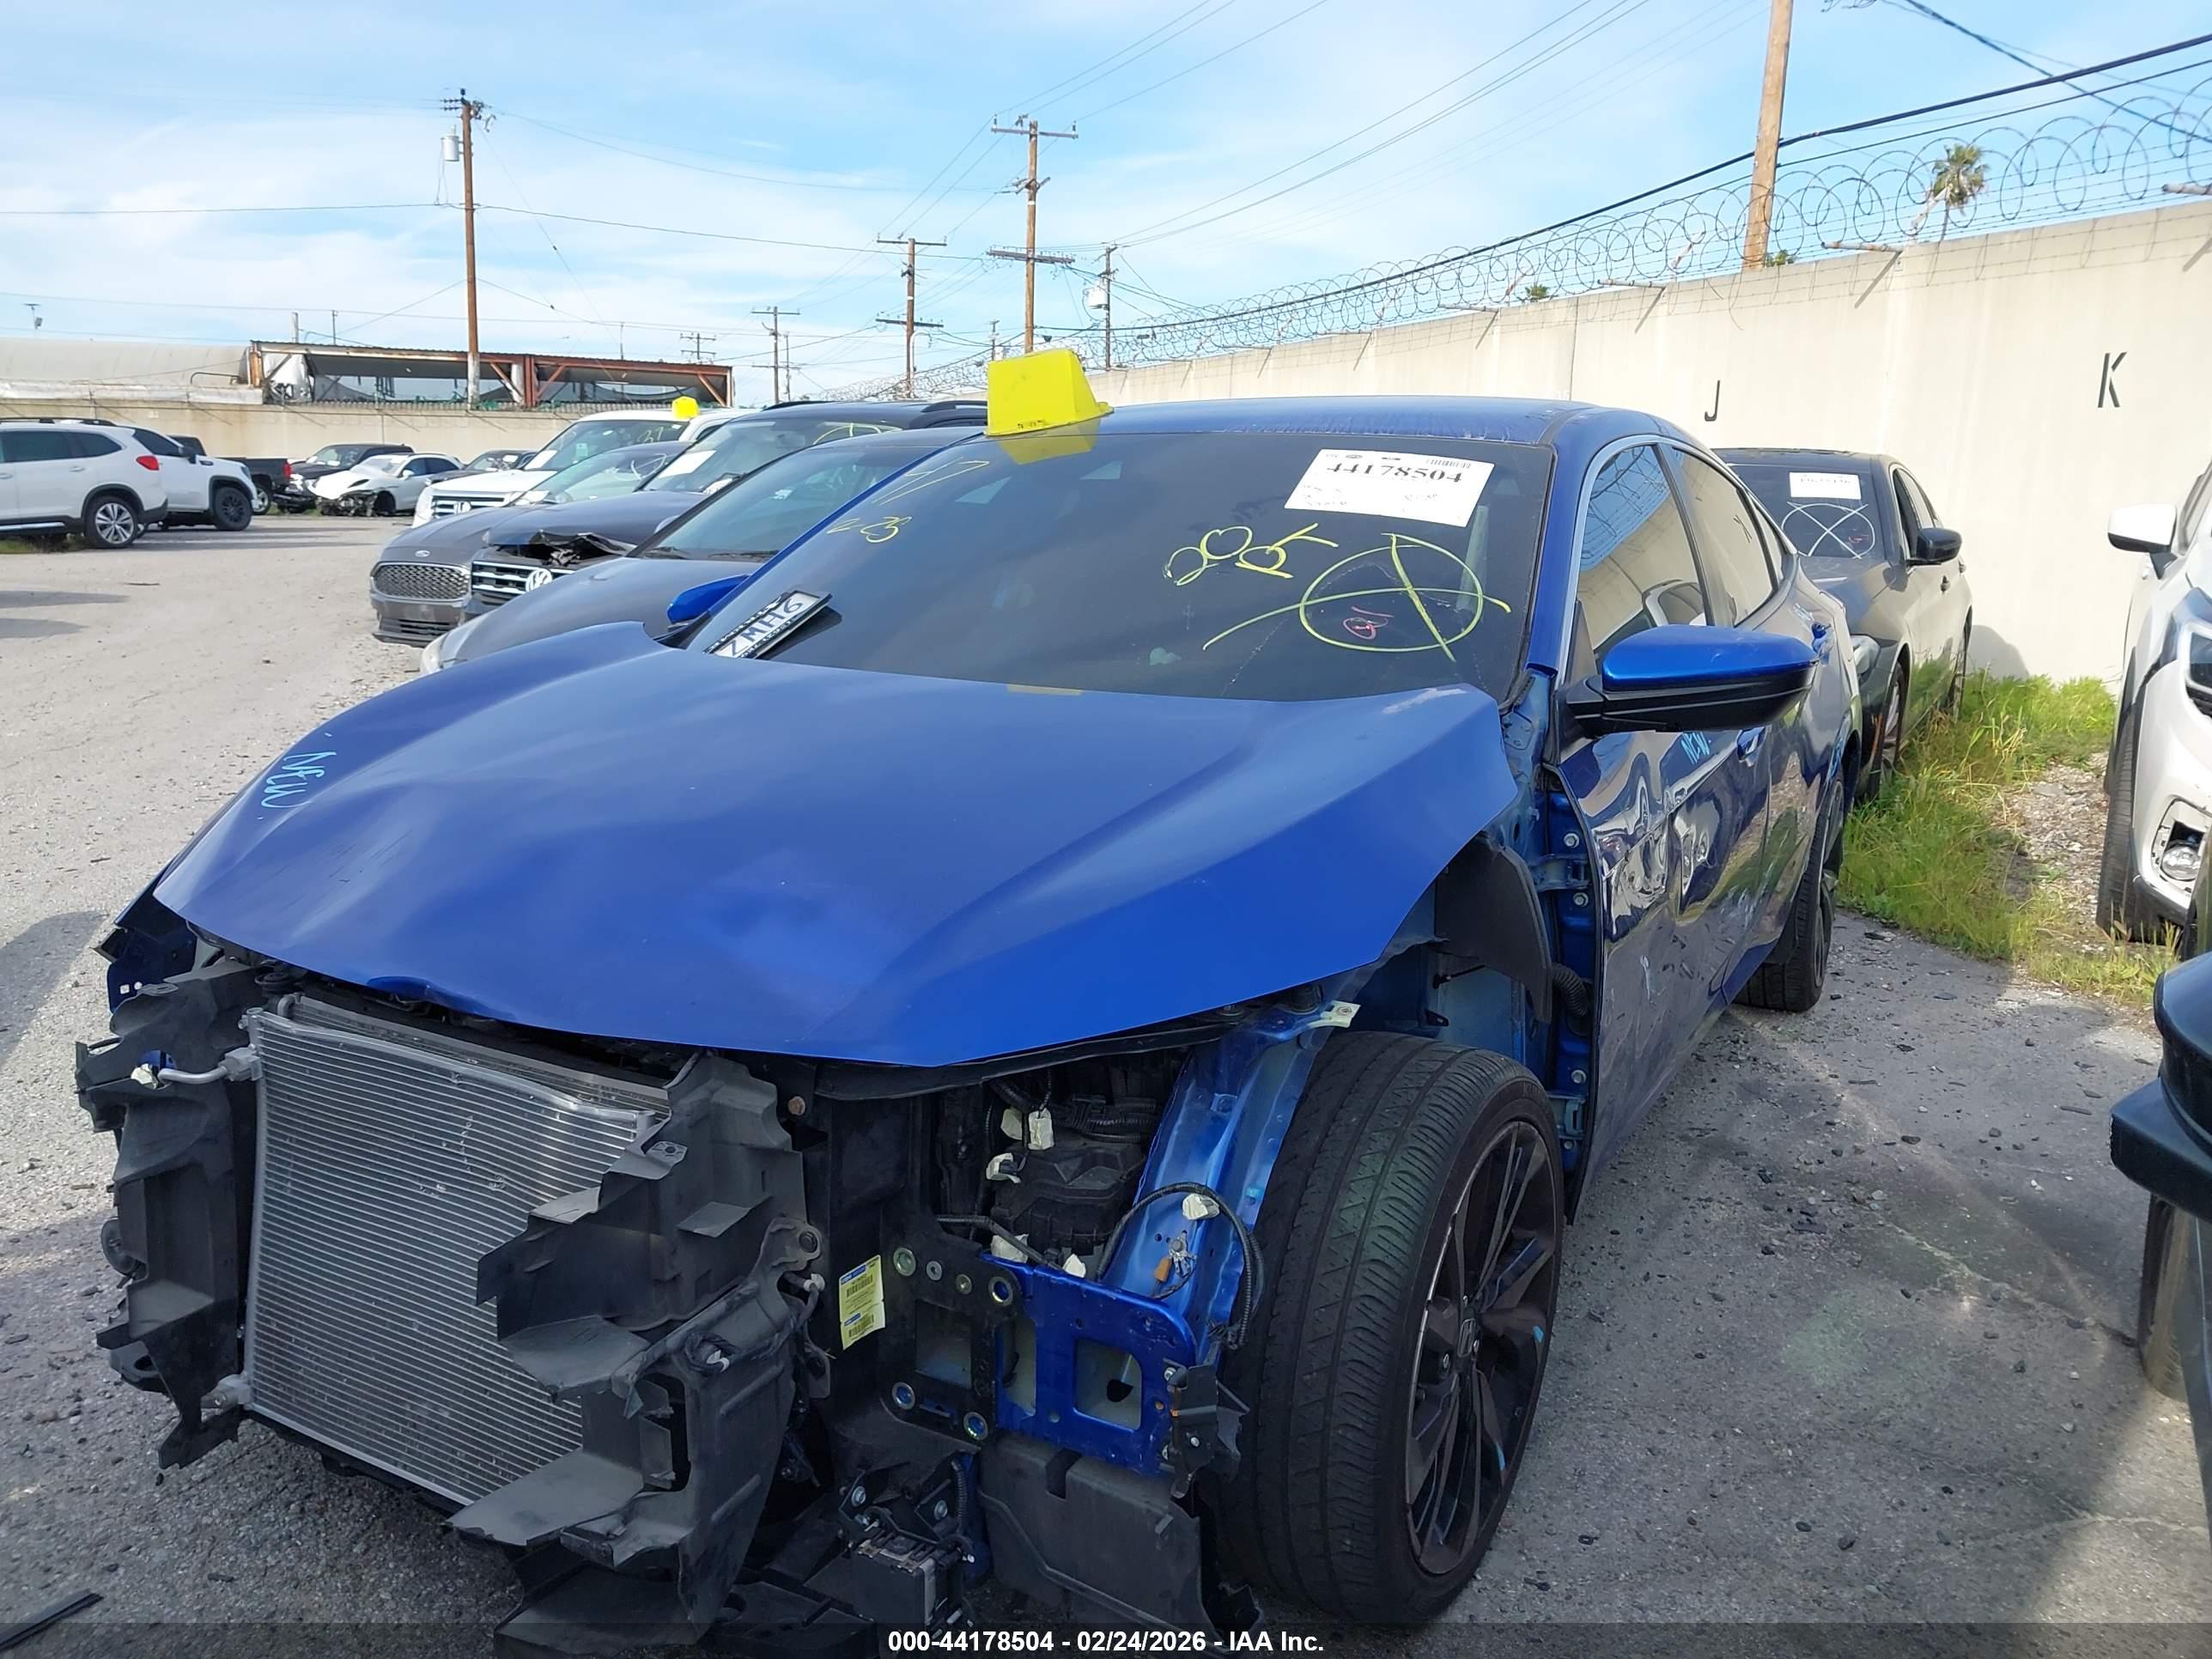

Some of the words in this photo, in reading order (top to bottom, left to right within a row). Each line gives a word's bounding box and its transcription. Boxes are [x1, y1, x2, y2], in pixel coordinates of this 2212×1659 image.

[1705, 379, 1721, 422] J
[2098, 351, 2128, 408] K
[1326, 462, 1462, 483] 44178504
